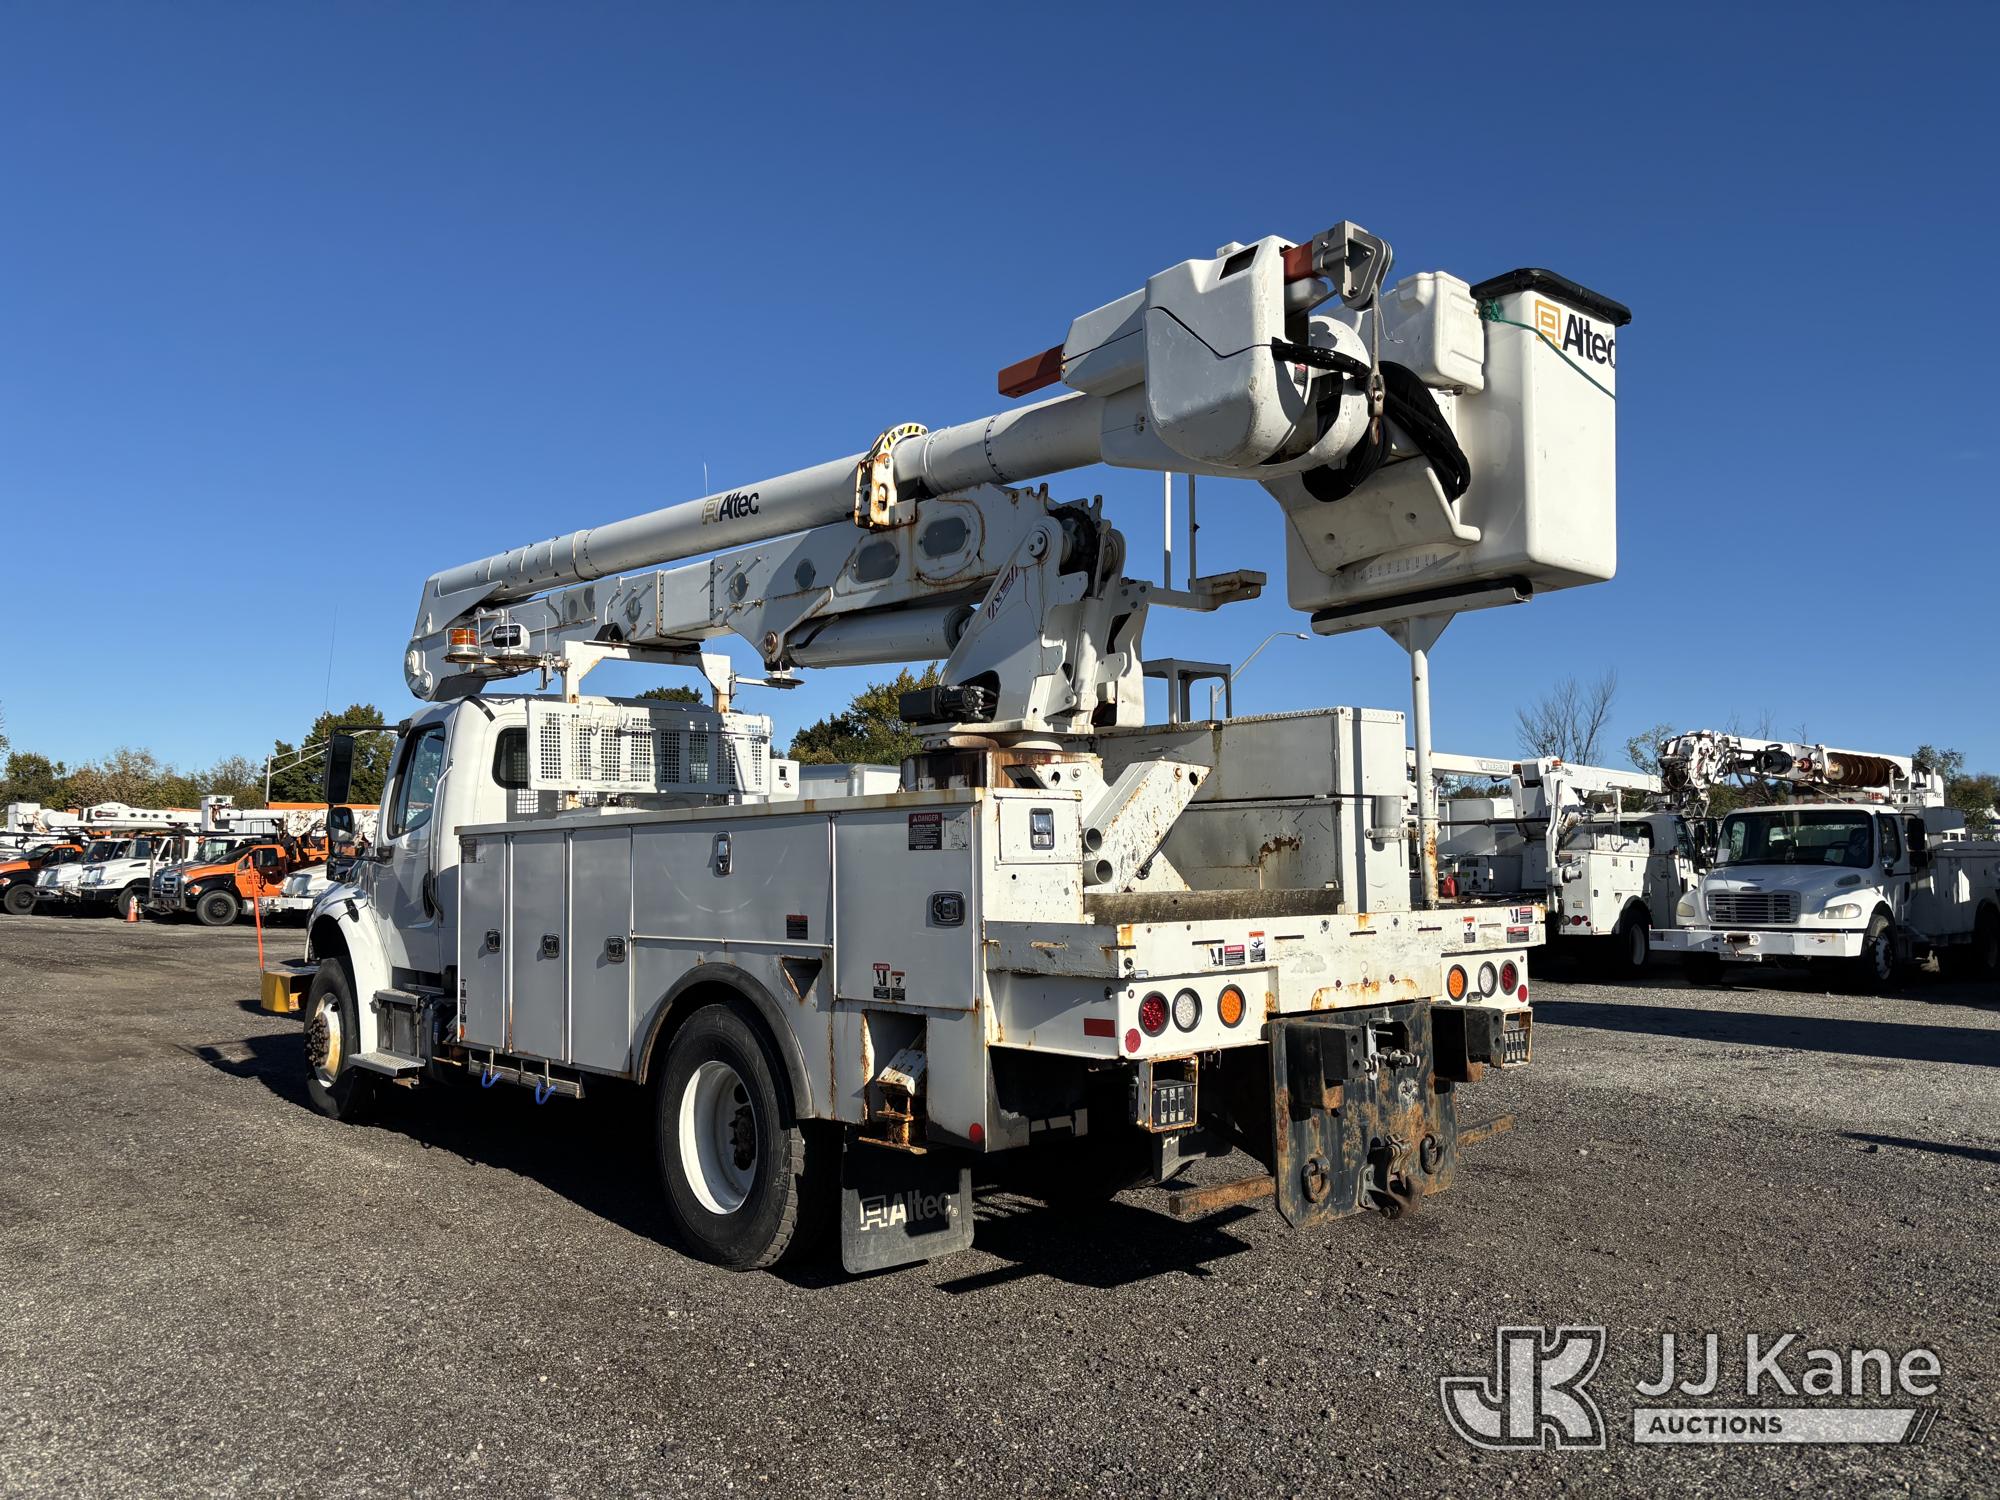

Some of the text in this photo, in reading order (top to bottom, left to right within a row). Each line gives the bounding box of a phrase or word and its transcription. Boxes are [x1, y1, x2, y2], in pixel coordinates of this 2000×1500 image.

[719, 491, 760, 522] Altec
[917, 814, 939, 822] DANGER
[889, 1189, 951, 1226] Altec
